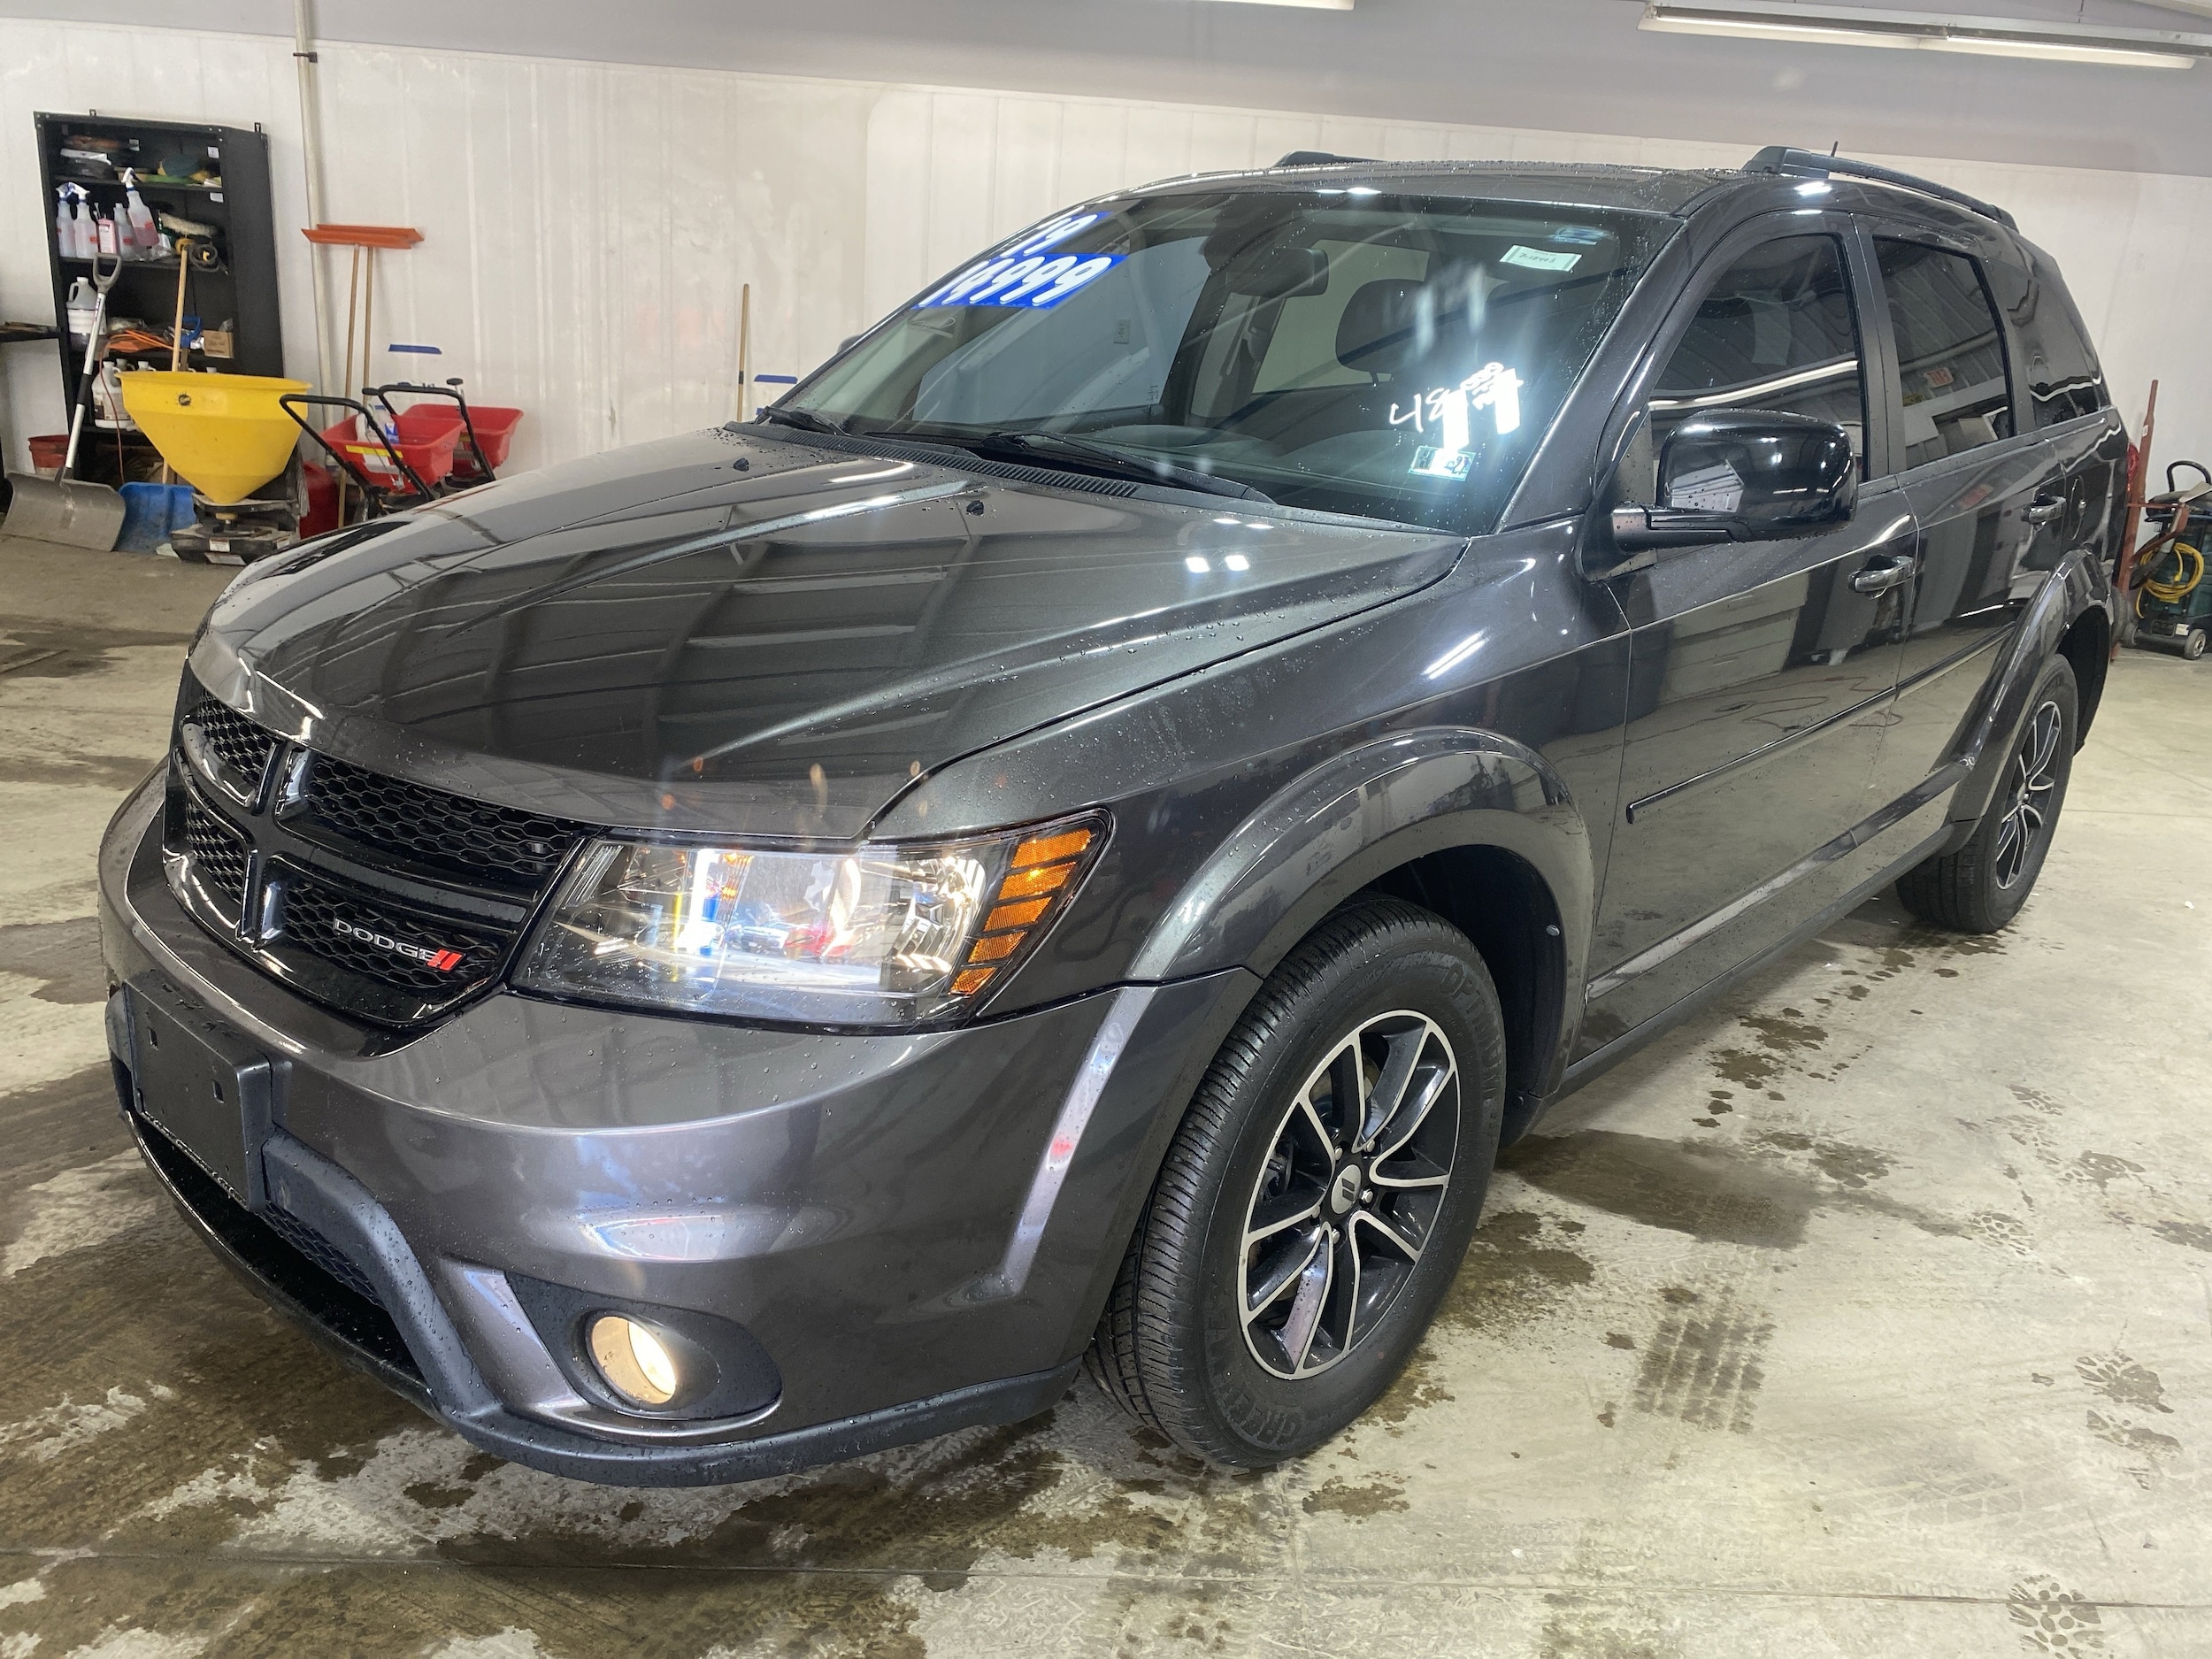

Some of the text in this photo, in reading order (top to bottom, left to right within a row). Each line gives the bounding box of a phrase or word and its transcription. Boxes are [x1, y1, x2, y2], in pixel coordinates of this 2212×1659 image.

[1000, 214, 1098, 257] 19
[918, 255, 1112, 307] 14999
[334, 918, 441, 964] DODGE
